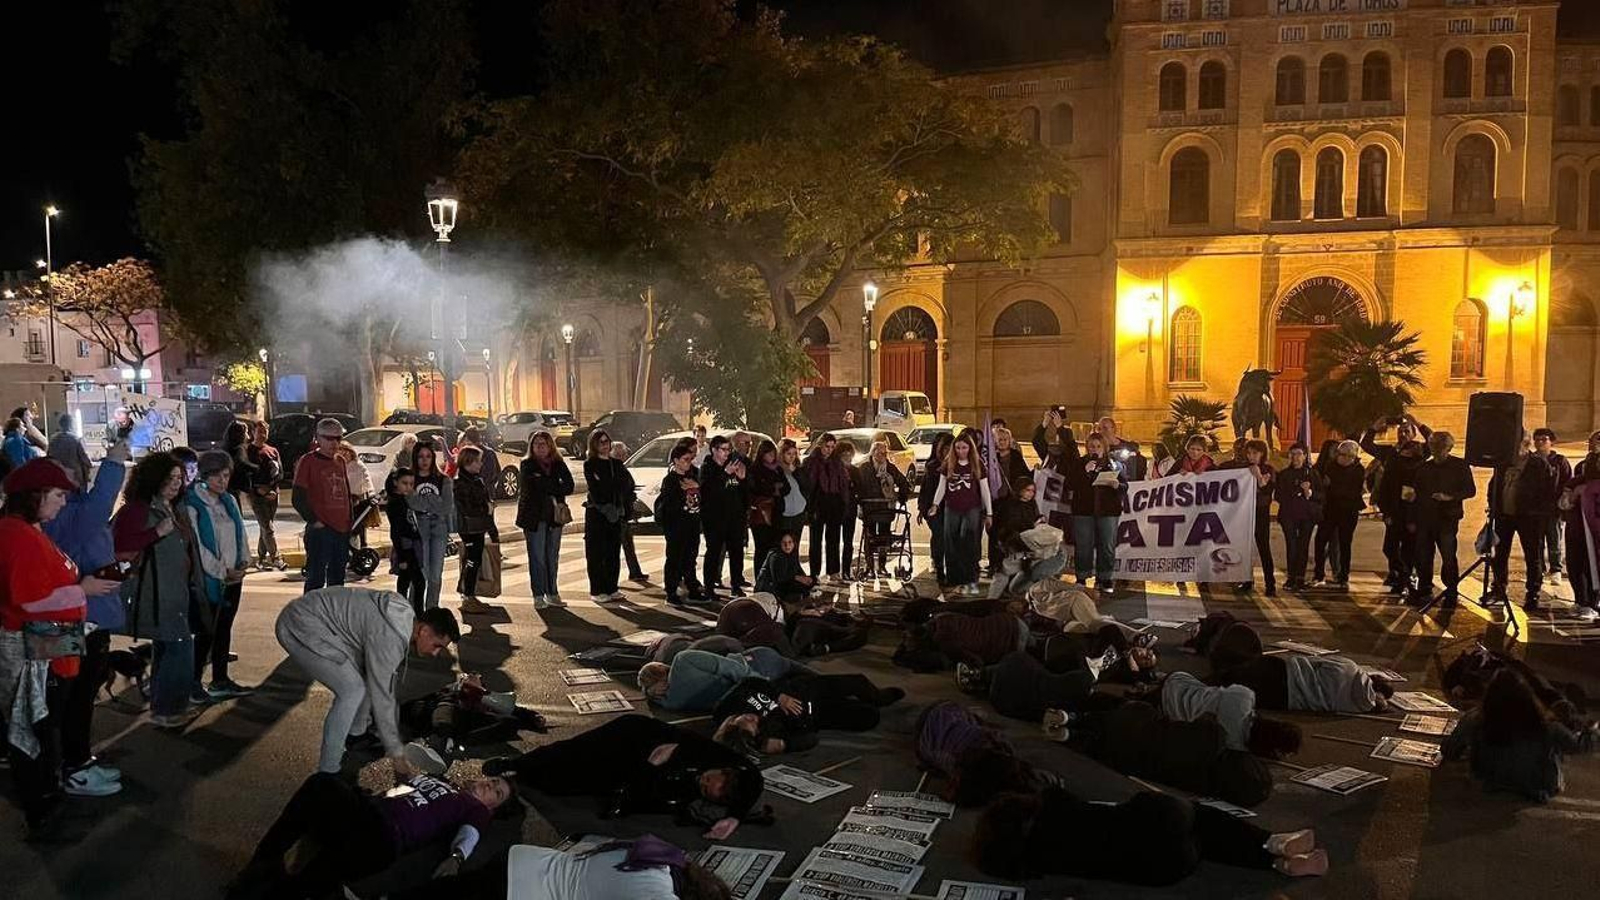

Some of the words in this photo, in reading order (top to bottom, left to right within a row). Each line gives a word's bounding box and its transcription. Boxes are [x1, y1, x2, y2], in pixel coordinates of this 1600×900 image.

[1276, 0, 1320, 12] PLAZA
[1328, 0, 1346, 11] DE
[1119, 479, 1239, 514] ACHISMO
